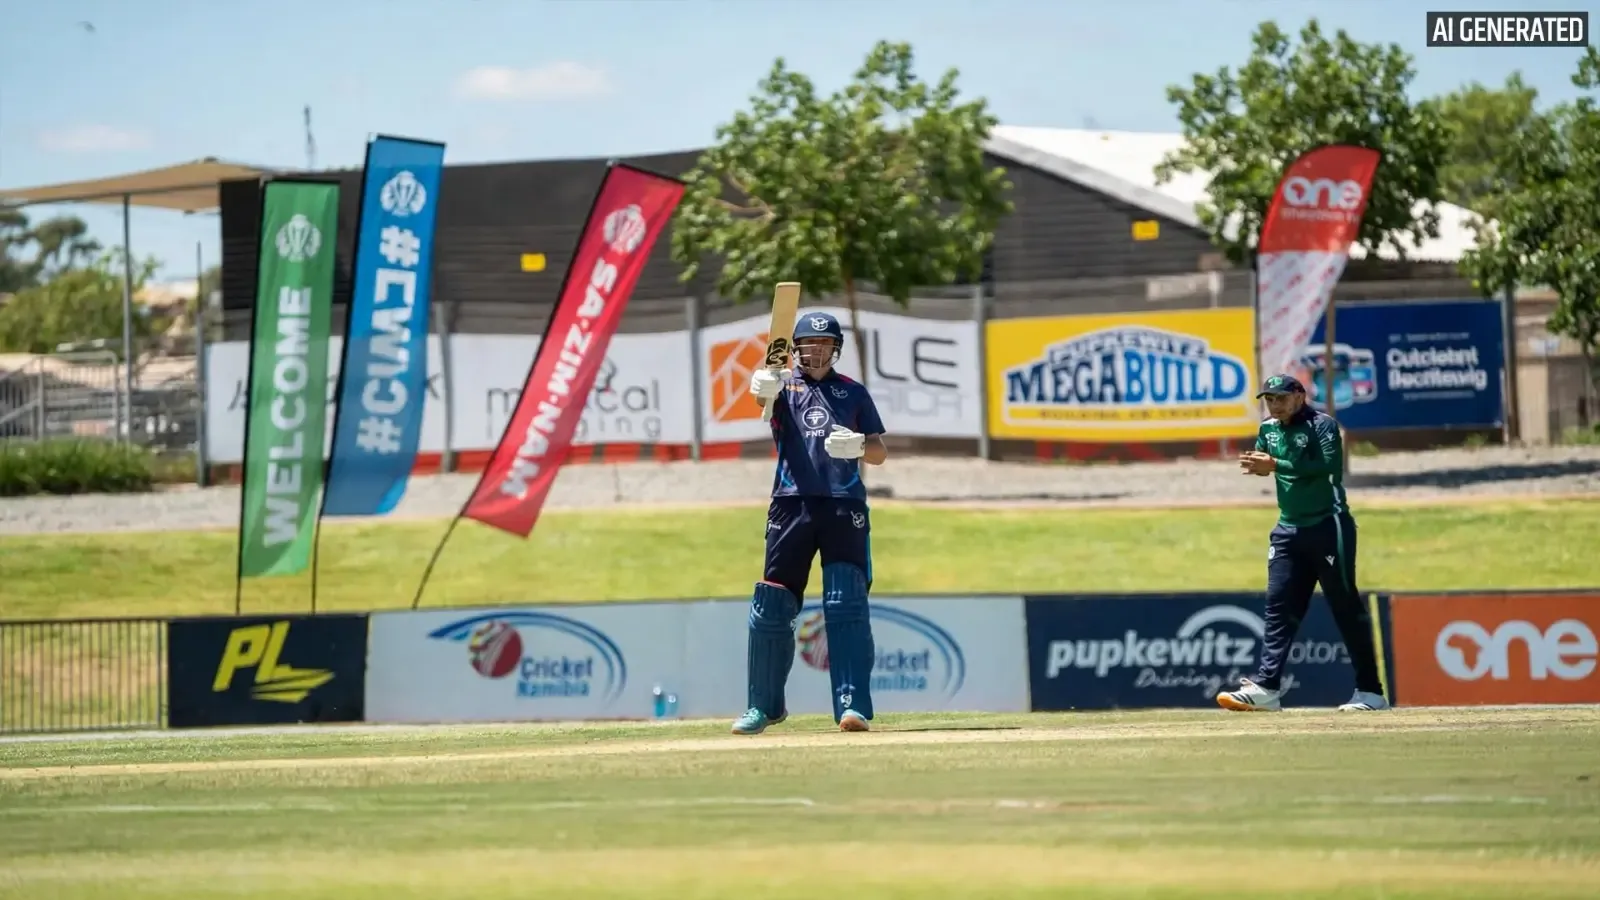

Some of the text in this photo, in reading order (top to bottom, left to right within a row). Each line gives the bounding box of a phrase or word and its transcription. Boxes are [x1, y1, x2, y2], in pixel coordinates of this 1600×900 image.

[1284, 176, 1362, 210] one
[1007, 349, 1247, 403] MEGABUILD
[263, 285, 312, 547] WELCOME
[805, 429, 825, 437] FNB
[212, 621, 333, 702] PL
[875, 646, 930, 671] icket
[1046, 629, 1352, 678] pupkewitz otors
[1435, 619, 1599, 681] one
